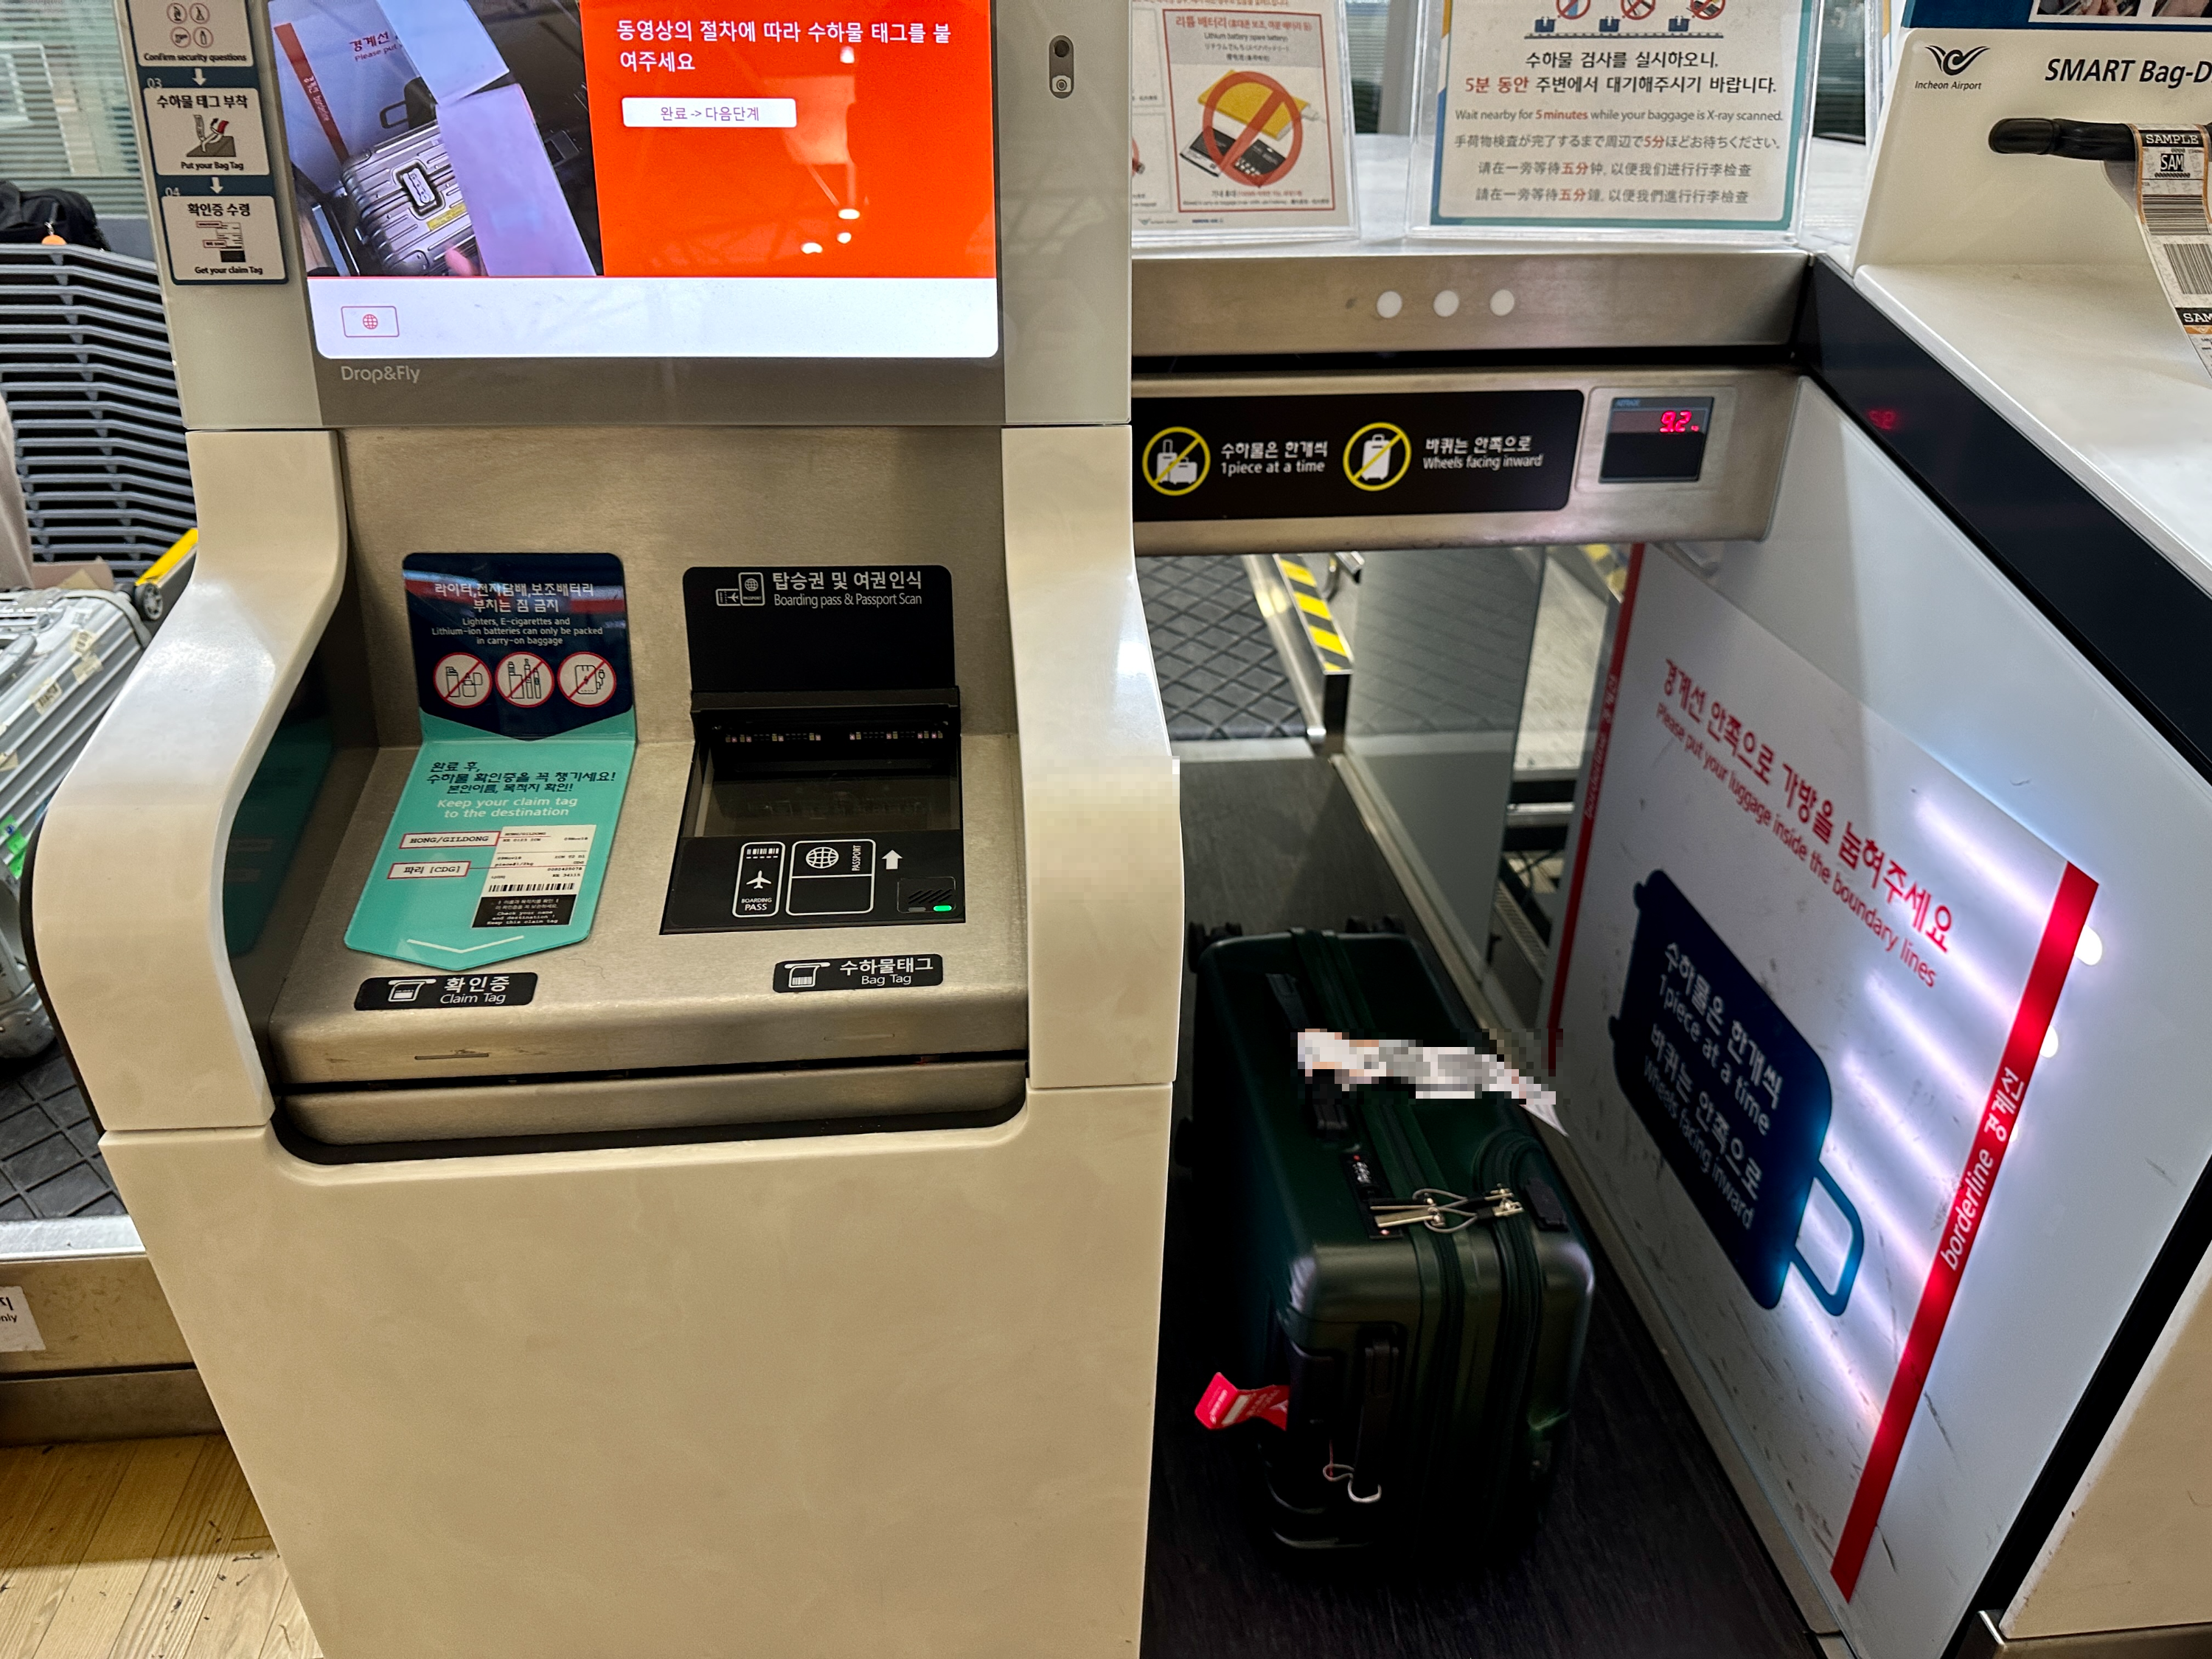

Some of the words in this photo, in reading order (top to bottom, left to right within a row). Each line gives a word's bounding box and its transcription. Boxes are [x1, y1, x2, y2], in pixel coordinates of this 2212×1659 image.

[616, 20, 692, 41] 동영상의
[700, 21, 756, 41] 절차에
[764, 21, 801, 42] 따라
[807, 22, 863, 43] 수하물
[871, 22, 926, 43] 태그를
[933, 24, 951, 43] 붙
[349, 31, 390, 52] 경계선
[144, 53, 175, 61] Confirm
[178, 53, 207, 63] security
[209, 53, 247, 63] questions
[620, 51, 695, 72] 여주세요
[1526, 52, 1572, 69] 수하물
[1581, 52, 1627, 68] 검사를
[2045, 58, 2135, 81] SMART
[2139, 60, 2212, 88] Bag-D
[1466, 77, 1489, 93] 5분
[1498, 77, 1529, 94] 동안
[1536, 77, 1598, 93] 주변에서
[1607, 77, 1701, 93] 대기해주시기
[1711, 77, 1776, 93] 바랍니다.
[1914, 81, 1948, 90] Incheon
[1951, 81, 1982, 91] Airport
[157, 95, 193, 108] 수하물
[196, 95, 220, 108] 태그
[224, 95, 248, 108] 부착
[661, 106, 687, 121] 완료
[705, 106, 759, 121] 다음단계
[1455, 111, 1478, 119] Wait
[1481, 111, 1516, 122] nearby
[1519, 110, 1533, 119] for
[1591, 110, 1619, 119] while
[1621, 111, 1645, 123] your
[1648, 110, 1694, 123] baggage
[1697, 111, 1705, 120] is
[1706, 111, 1734, 122] X-ray
[1736, 111, 1783, 121] scanned.
[2146, 134, 2199, 144] SAMPLE
[196, 163, 212, 171] your
[214, 161, 229, 171] Bag
[230, 161, 243, 171] Tag
[187, 204, 223, 217] 확인증
[227, 204, 251, 217] 수령
[195, 266, 208, 274] Get
[209, 268, 227, 276] your
[229, 266, 248, 274] claim
[250, 267, 262, 276] Tag
[341, 366, 420, 383] Drop&Fly
[1221, 442, 1278, 459] 수하물은
[1285, 442, 1327, 459] 한개씩
[1426, 438, 1469, 454] 바퀴는
[1475, 437, 1532, 453] 안쪽으로
[1265, 461, 1280, 473] at
[1283, 463, 1292, 473] a
[1296, 460, 1324, 473] time
[1423, 456, 1463, 470] Wheels
[1465, 455, 1500, 471] facing
[1503, 454, 1543, 468] inward
[773, 572, 824, 590] 탑승권
[832, 572, 849, 590] 및
[473, 599, 512, 613] 부치는
[517, 599, 529, 613] 짐
[535, 599, 559, 613] 금지
[774, 593, 818, 608] Boarding
[820, 596, 842, 608] pass
[844, 594, 854, 605] &
[855, 593, 897, 608] Passport
[899, 593, 922, 605] Scan
[463, 618, 498, 627] Lighters,
[501, 618, 552, 627] E-cigarettes
[432, 627, 481, 636] Lithium-ion
[484, 627, 521, 636] batteries
[540, 627, 558, 636] only
[560, 627, 571, 635] be
[574, 627, 603, 636] packed
[487, 638, 525, 646] carry-on
[528, 637, 563, 646] baggage
[431, 762, 459, 773] 완료
[465, 762, 480, 773] 후,
[426, 773, 468, 785] 수하물
[473, 773, 530, 783] 확인증을
[536, 773, 549, 782] 꼭
[554, 771, 616, 782] 챙기세요!
[447, 784, 498, 794] 본인이름,
[504, 783, 540, 793] 목적지
[545, 783, 574, 793] 확인!
[437, 799, 472, 810] Keep
[476, 800, 509, 810] your
[513, 798, 550, 807] claim
[556, 798, 578, 808] tag
[1666, 658, 1706, 723] 경계선
[1708, 701, 1775, 785] 안쪽으로
[1782, 762, 1834, 845] 가방을
[1838, 820, 1952, 953] 눕혀주세요
[444, 810, 459, 818] to
[490, 808, 569, 817] destination
[409, 836, 490, 844] HONG/GILDONG
[1656, 702, 1686, 742] Please
[1685, 734, 1703, 759] put
[1703, 751, 1728, 782] your
[1728, 771, 1772, 826] luggage
[1773, 814, 1807, 862] inside
[1809, 849, 1831, 884] the
[1832, 872, 1899, 951] boundary
[1900, 938, 1936, 987] lines
[852, 844, 861, 872] PASSPORT
[403, 866, 425, 874] 파리
[430, 866, 460, 874] [CDG]
[839, 958, 933, 975] 수하물태그
[444, 976, 509, 993] 확인증
[861, 975, 885, 987] Bag
[890, 973, 911, 985] Tag
[440, 994, 478, 1004] Claim
[484, 992, 506, 1004] Tag
[1665, 942, 1724, 1037] 수하물은
[1728, 1020, 1783, 1110] 한개씩
[1702, 1037, 1719, 1068] at
[1720, 1062, 1733, 1085] a
[1735, 1075, 1770, 1135] time
[1651, 1023, 1693, 1103] 바퀴는
[1696, 1090, 1762, 1200] 안쪽으로
[1680, 1107, 1712, 1174] facing
[1712, 1156, 1755, 1230] inward
[1940, 1149, 1993, 1271] borderline
[1983, 1067, 2025, 1142] 경계선
[0, 1313, 17, 1324] nly
